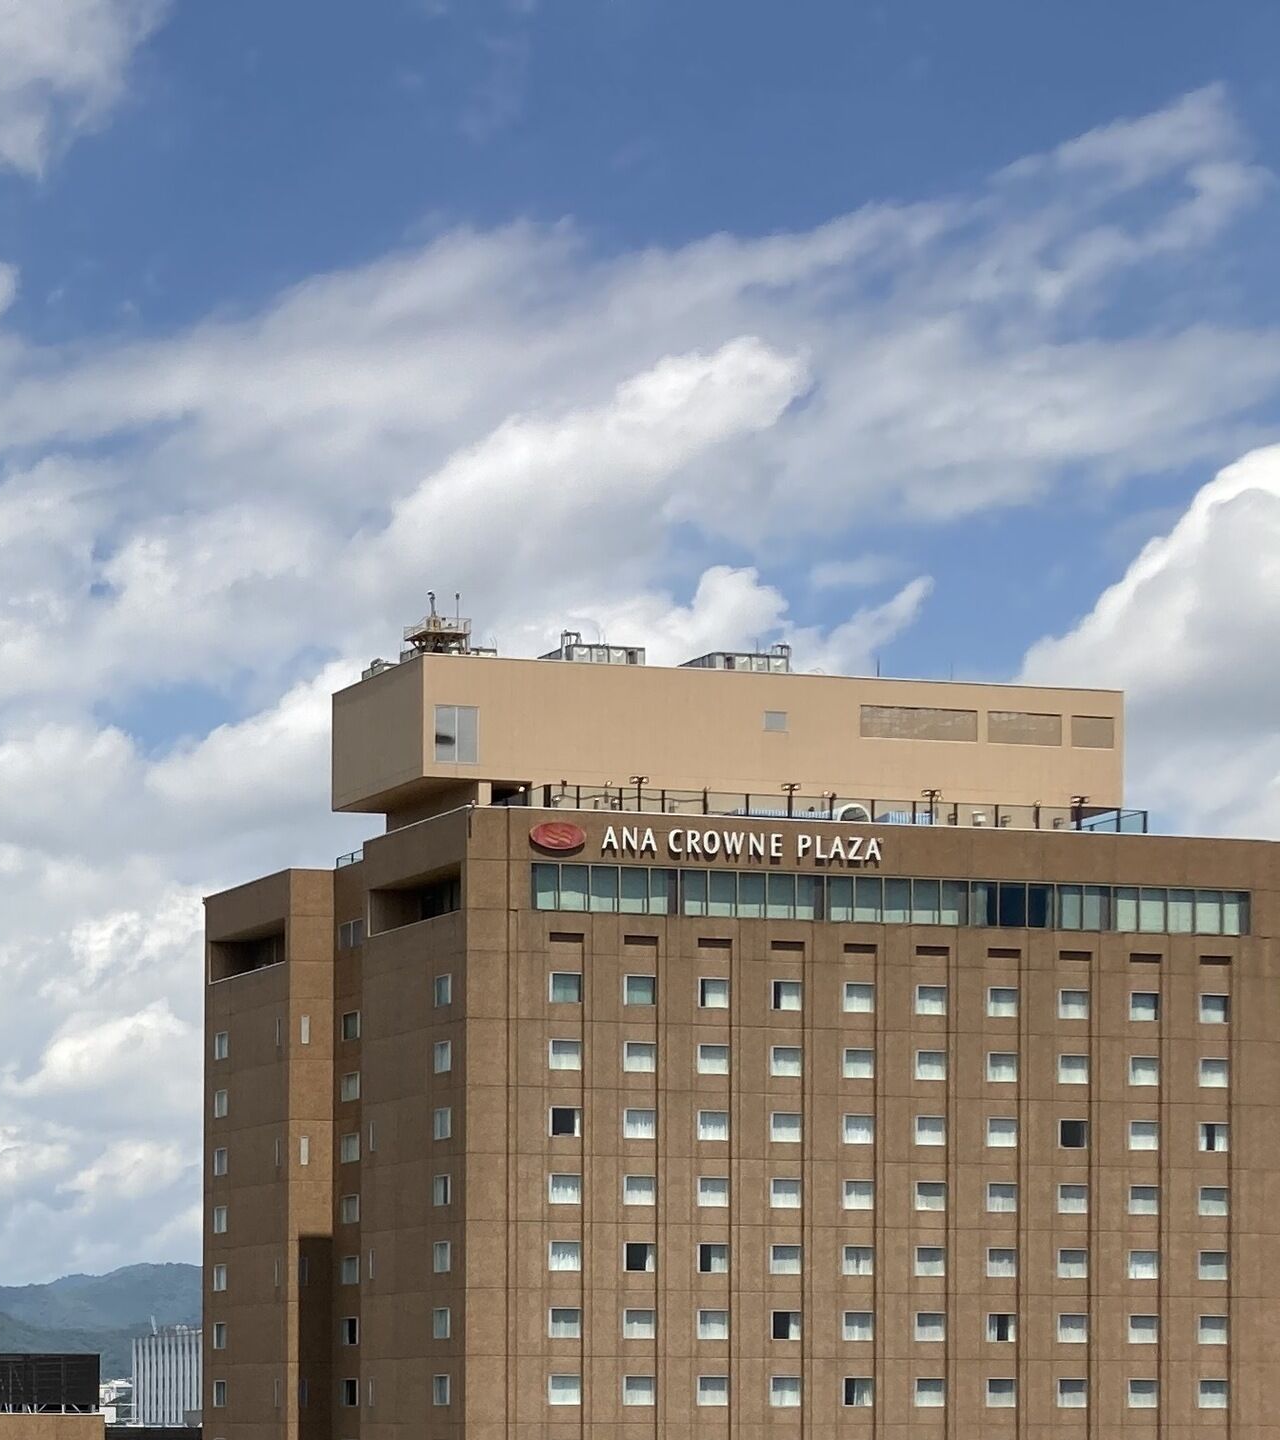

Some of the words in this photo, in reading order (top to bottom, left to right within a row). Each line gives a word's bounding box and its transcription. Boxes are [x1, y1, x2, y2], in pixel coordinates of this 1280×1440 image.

[601, 825, 657, 853] ANA
[668, 829, 783, 857] CROWNE
[797, 834, 882, 862] PLAZA
